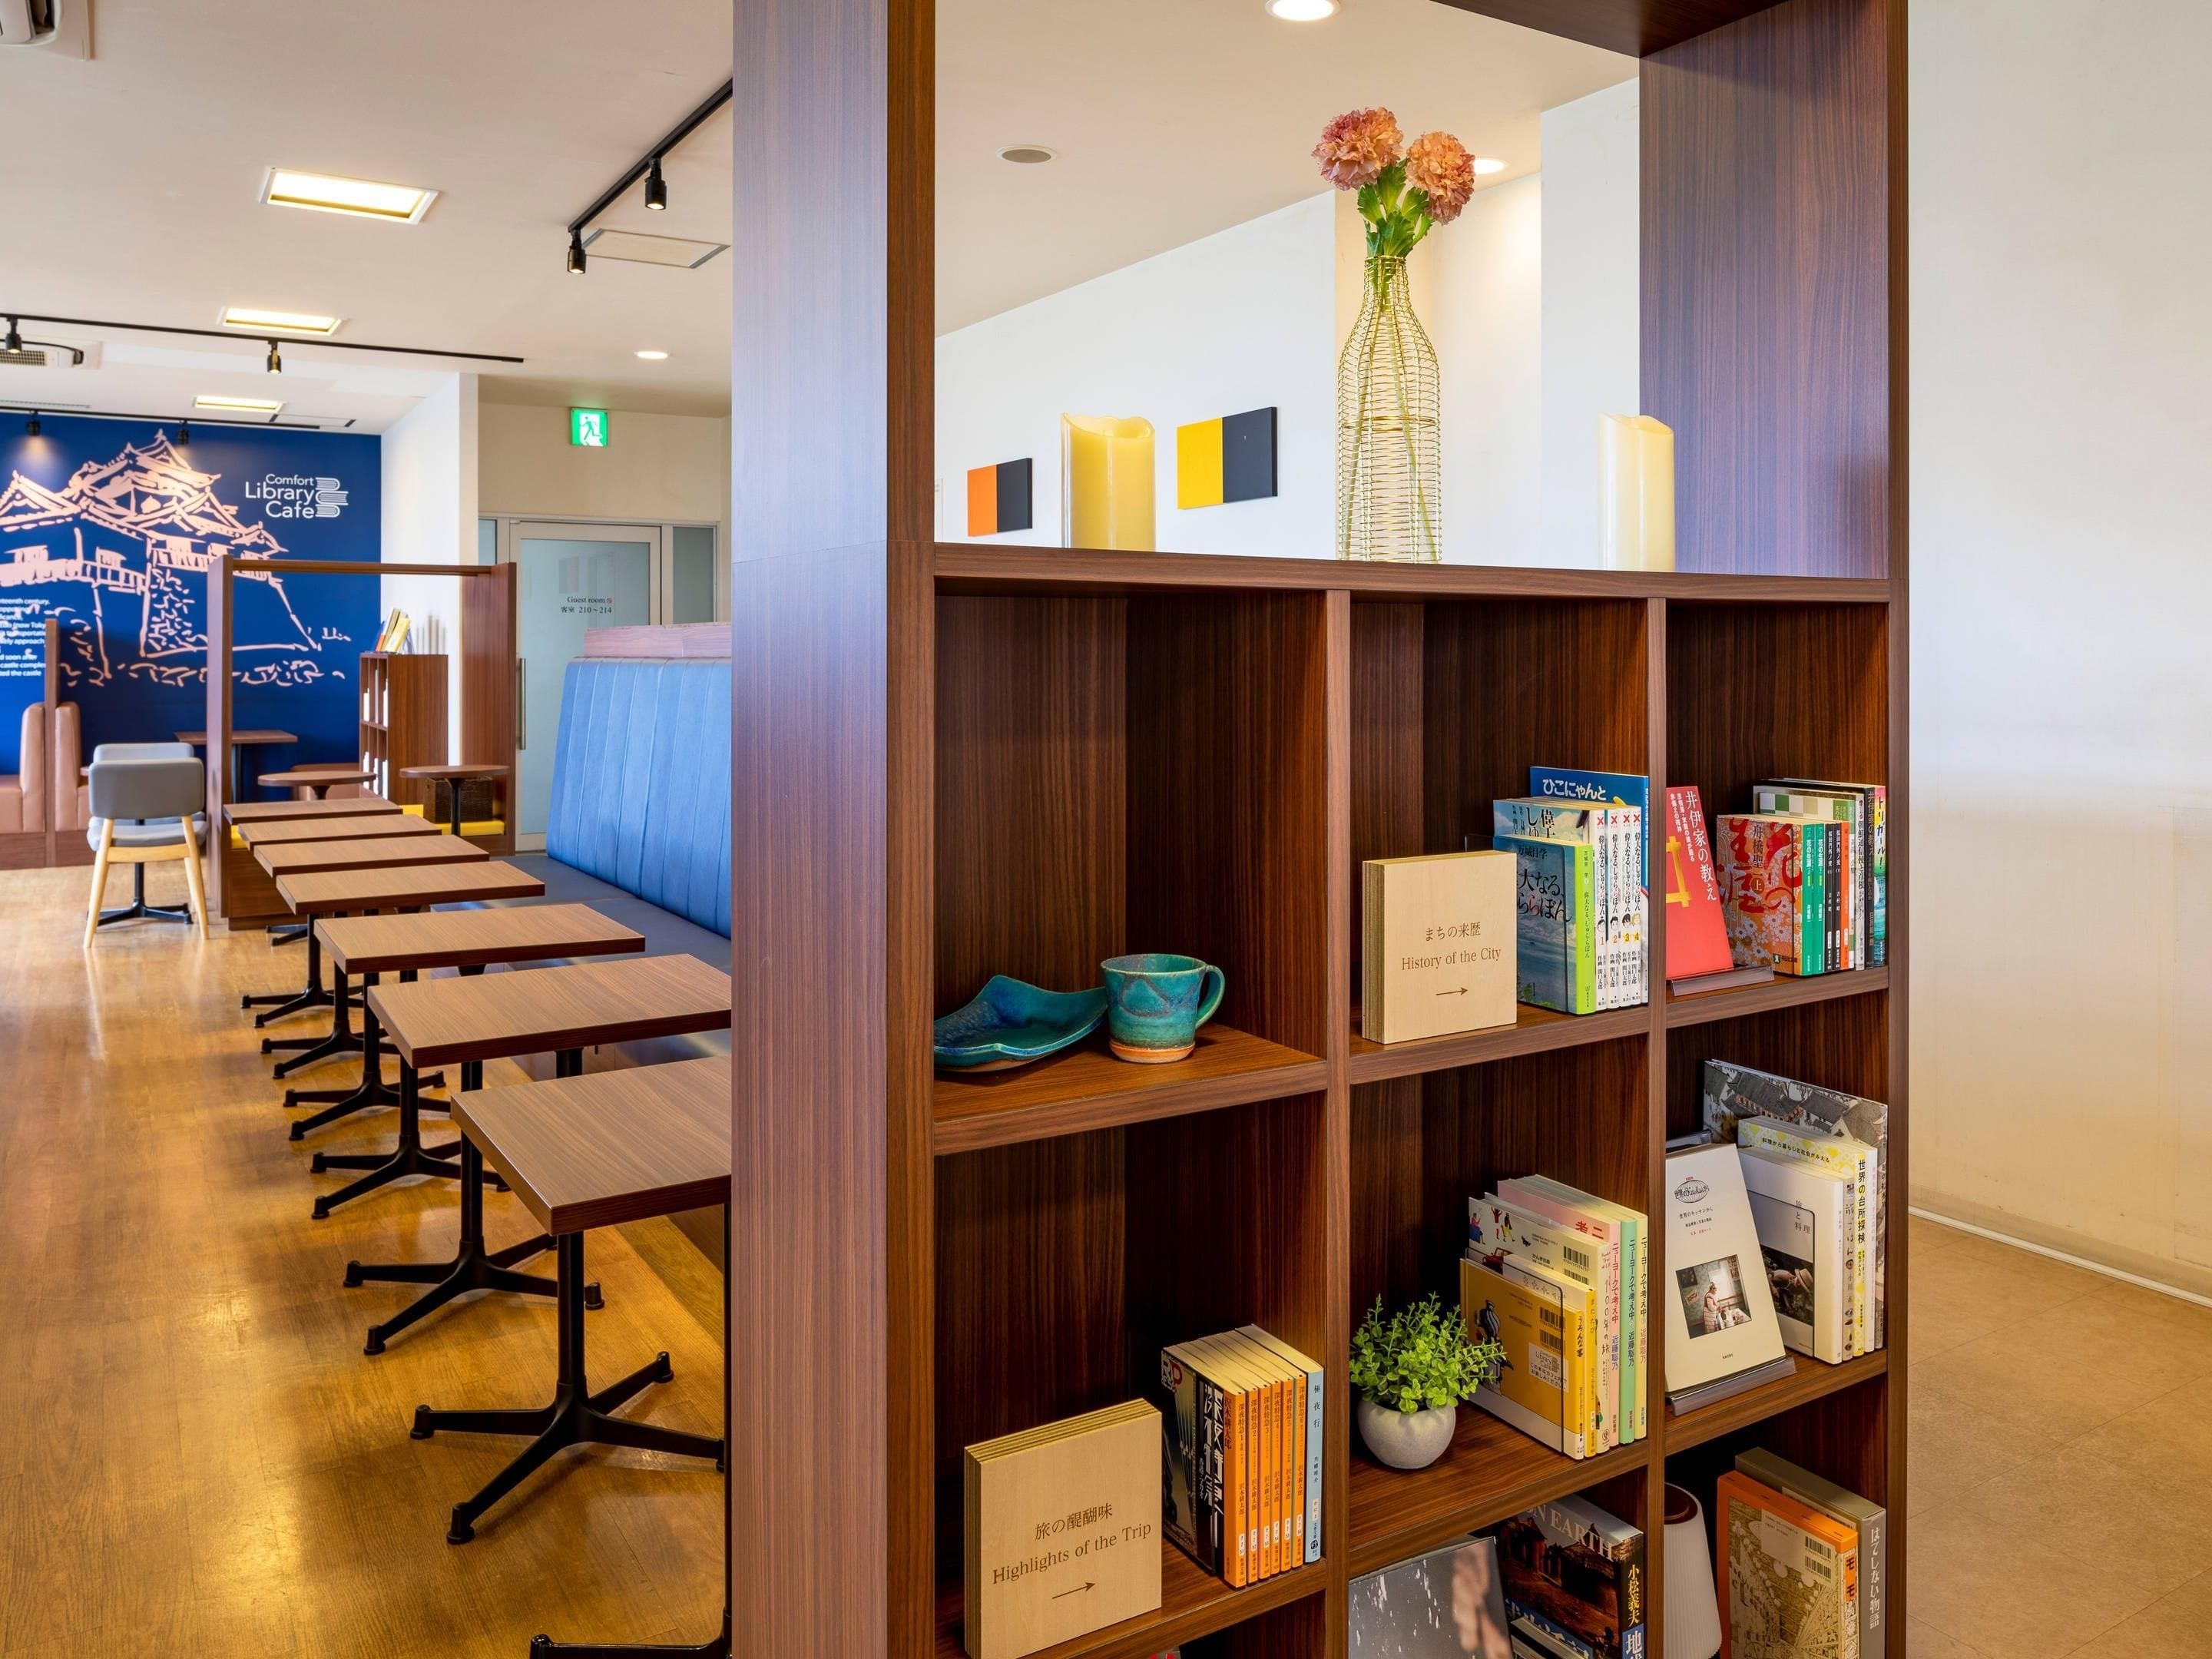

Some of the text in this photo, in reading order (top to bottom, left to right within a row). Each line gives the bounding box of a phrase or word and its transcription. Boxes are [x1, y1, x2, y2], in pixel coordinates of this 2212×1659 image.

[266, 473, 313, 485] Comfort
[245, 481, 313, 505] Library
[266, 500, 314, 518] Cafe
[1542, 779, 1606, 800] ひこにゃんと
[1685, 791, 1717, 901] 井伊家の教え
[1753, 824, 1763, 876] 舟橋聖一
[1518, 869, 1565, 897] 大なる、
[1756, 879, 1763, 892] 上
[1426, 922, 1481, 942] まちの来歴
[1613, 935, 1618, 943] 2
[1624, 933, 1630, 942] 3
[1634, 932, 1640, 940] 4
[1402, 947, 1502, 970] History of the City
[1035, 1502, 1113, 1541] 旅の醍醐味
[1551, 1508, 1614, 1562] EARTH
[992, 1549, 1069, 1584] Highlights
[1075, 1539, 1090, 1558] of
[1094, 1535, 1117, 1551] the
[1121, 1522, 1151, 1542] Trip
[1846, 1557, 1856, 1598] モモ
[1869, 1527, 1880, 1629] はてしない物語
[1628, 1565, 1640, 1628] 小松義夫
[1626, 1630, 1643, 1659] 地
